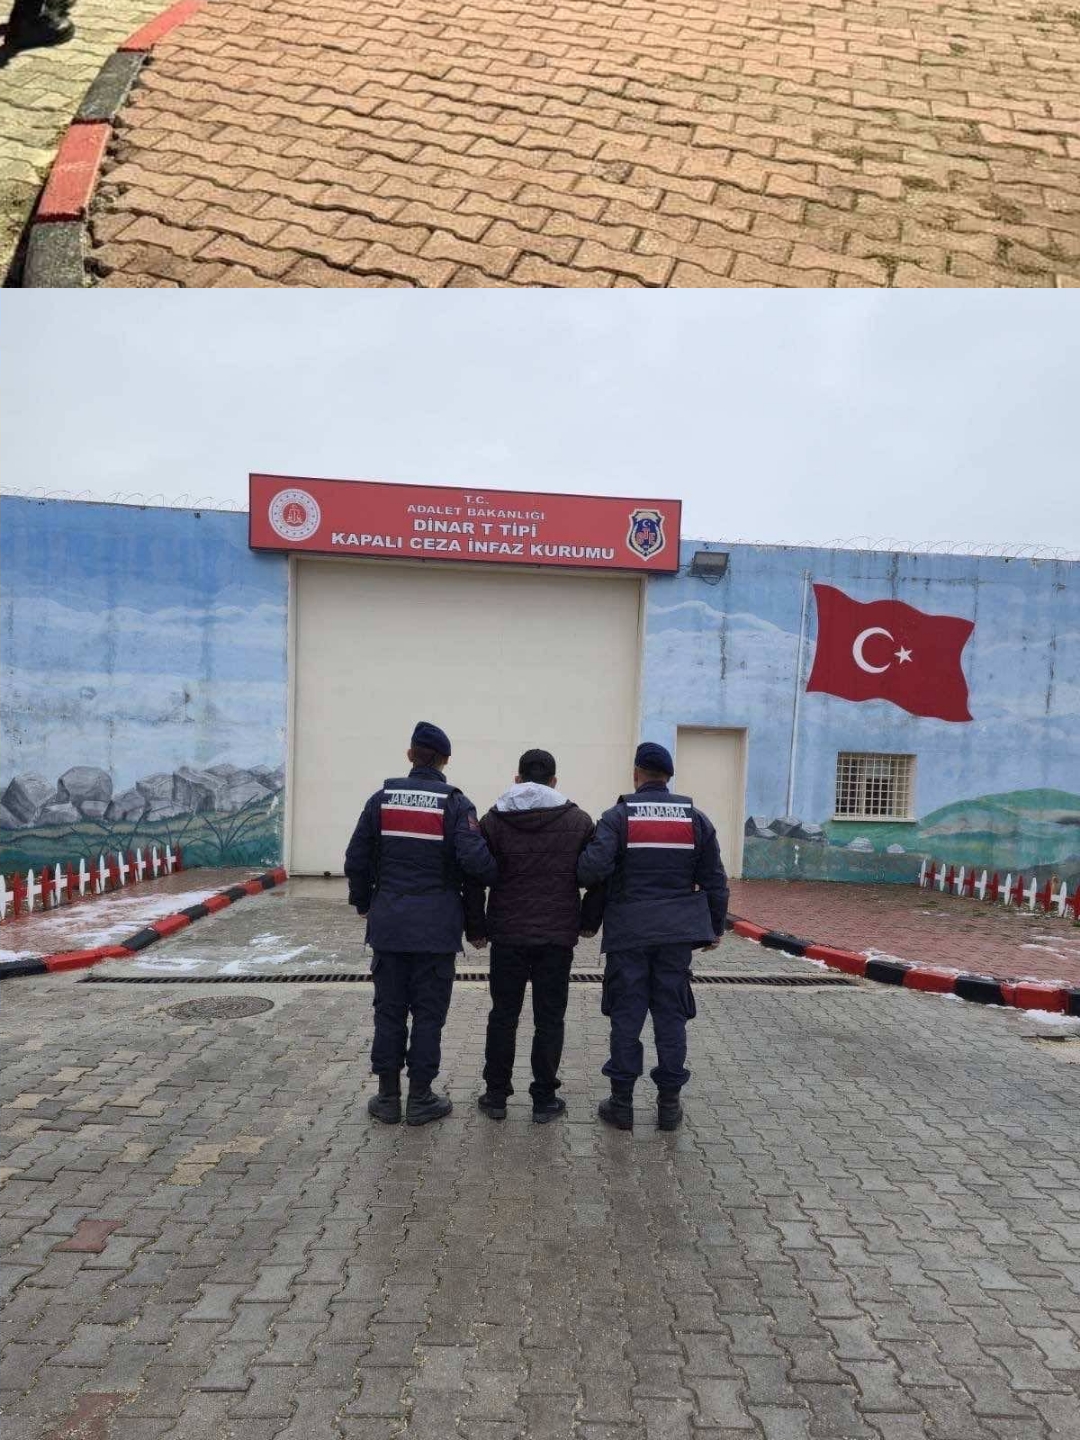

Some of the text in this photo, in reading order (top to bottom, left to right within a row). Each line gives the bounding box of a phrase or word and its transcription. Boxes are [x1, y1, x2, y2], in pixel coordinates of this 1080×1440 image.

[464, 495, 489, 505] T.C.
[407, 504, 462, 515] ADALET
[413, 517, 537, 538] DİNAR T TİPİ
[331, 532, 615, 560] KAPALI CEZA İNFAZ KURUMU
[388, 792, 438, 807] JANDARMA
[634, 805, 687, 818] JANDARMA
